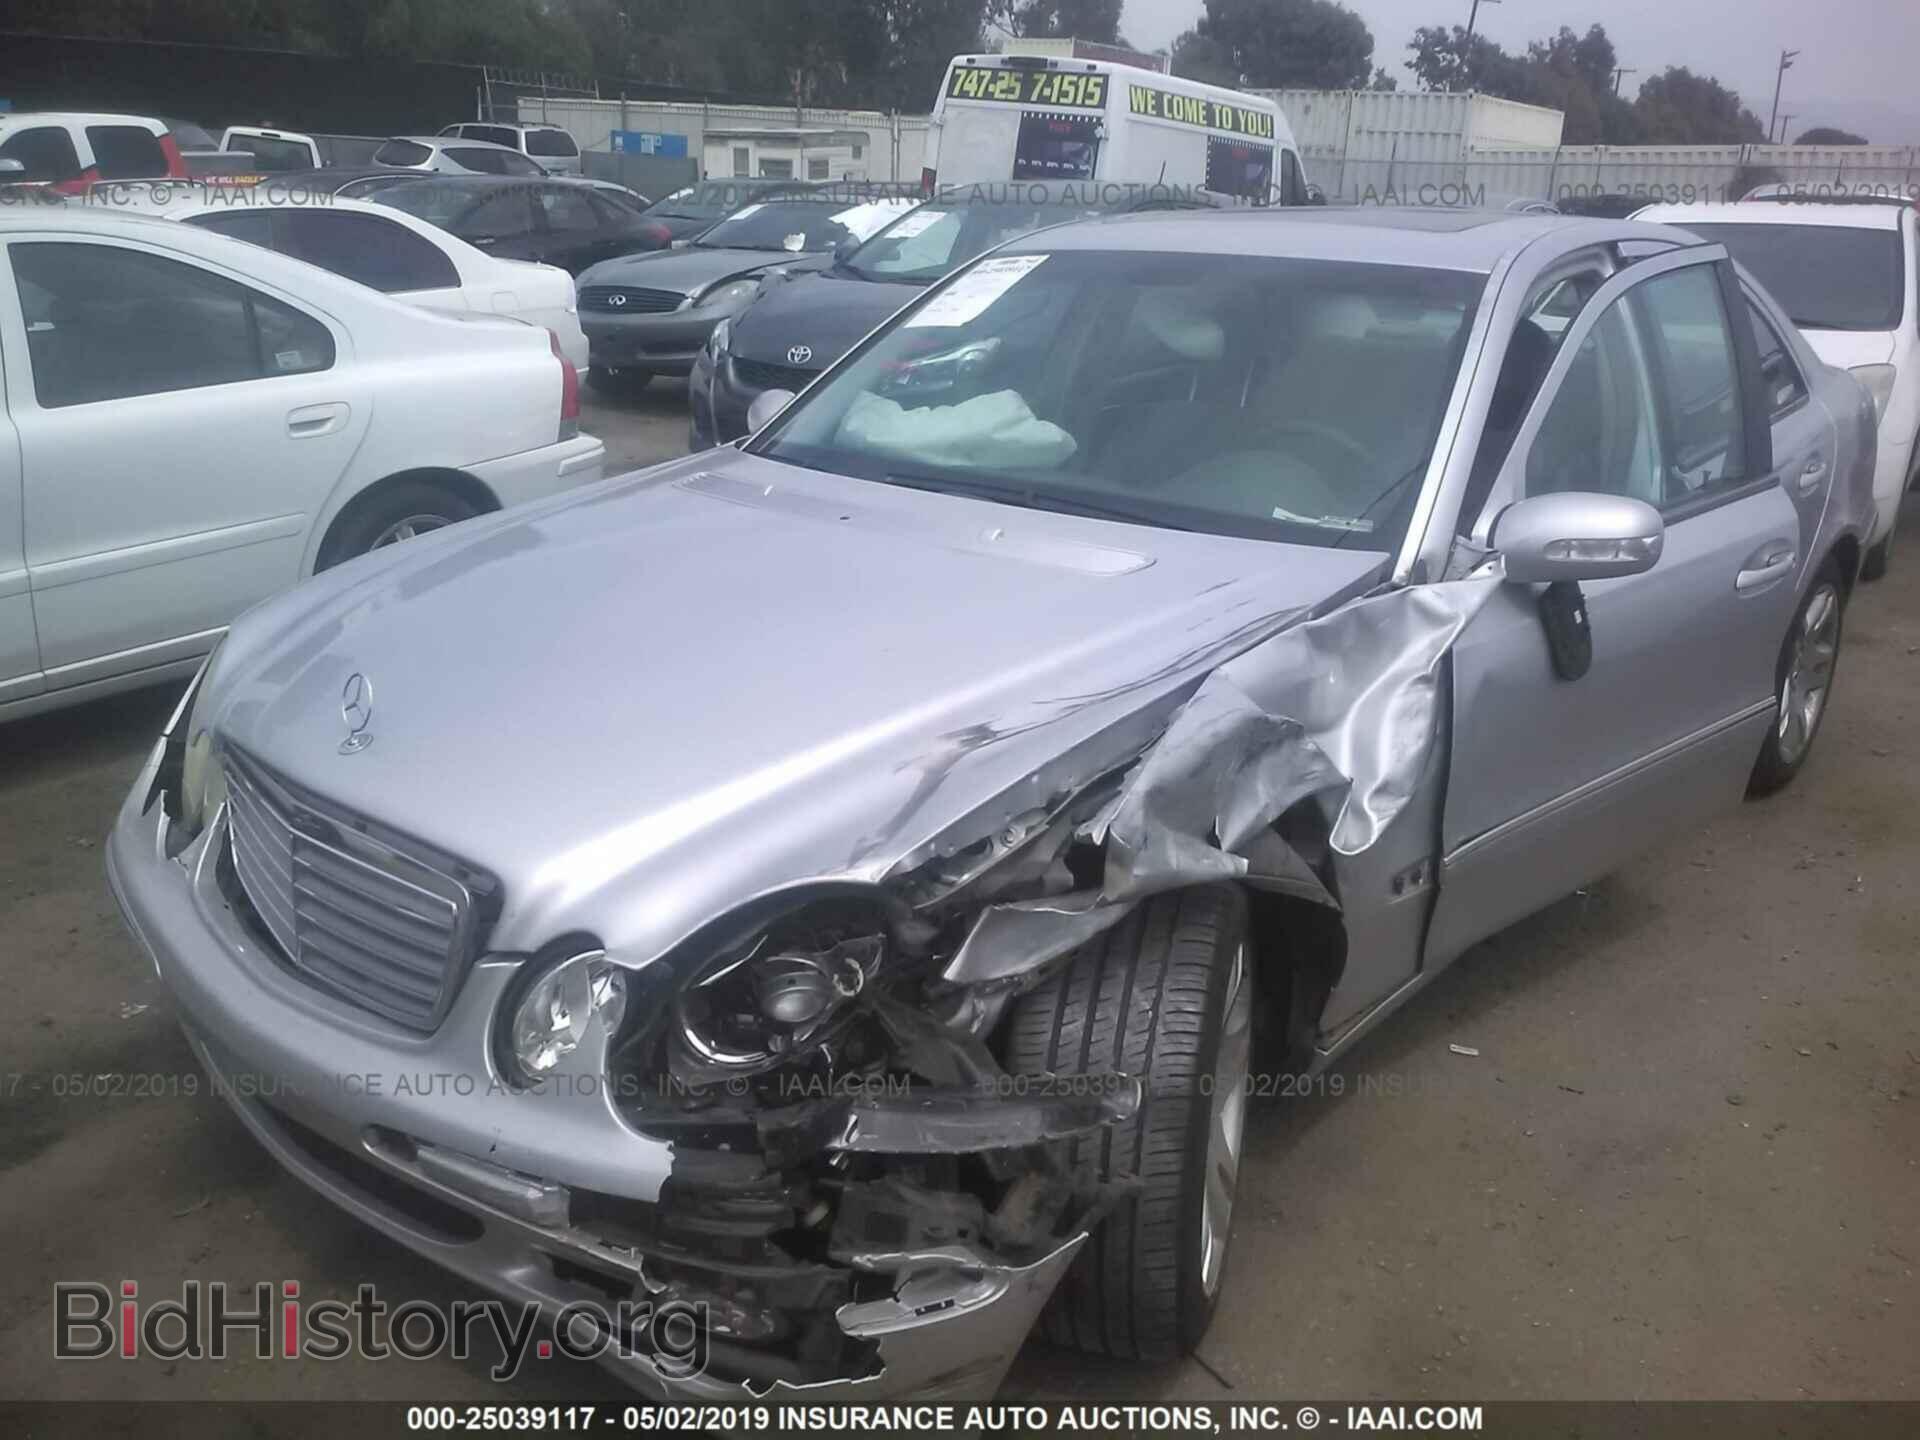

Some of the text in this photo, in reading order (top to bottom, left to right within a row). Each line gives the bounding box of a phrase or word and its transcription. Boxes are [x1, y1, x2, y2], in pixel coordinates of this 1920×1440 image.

[952, 68, 1103, 106] 747-25 7-1515
[1131, 86, 1272, 137] WE COME TO YOU!
